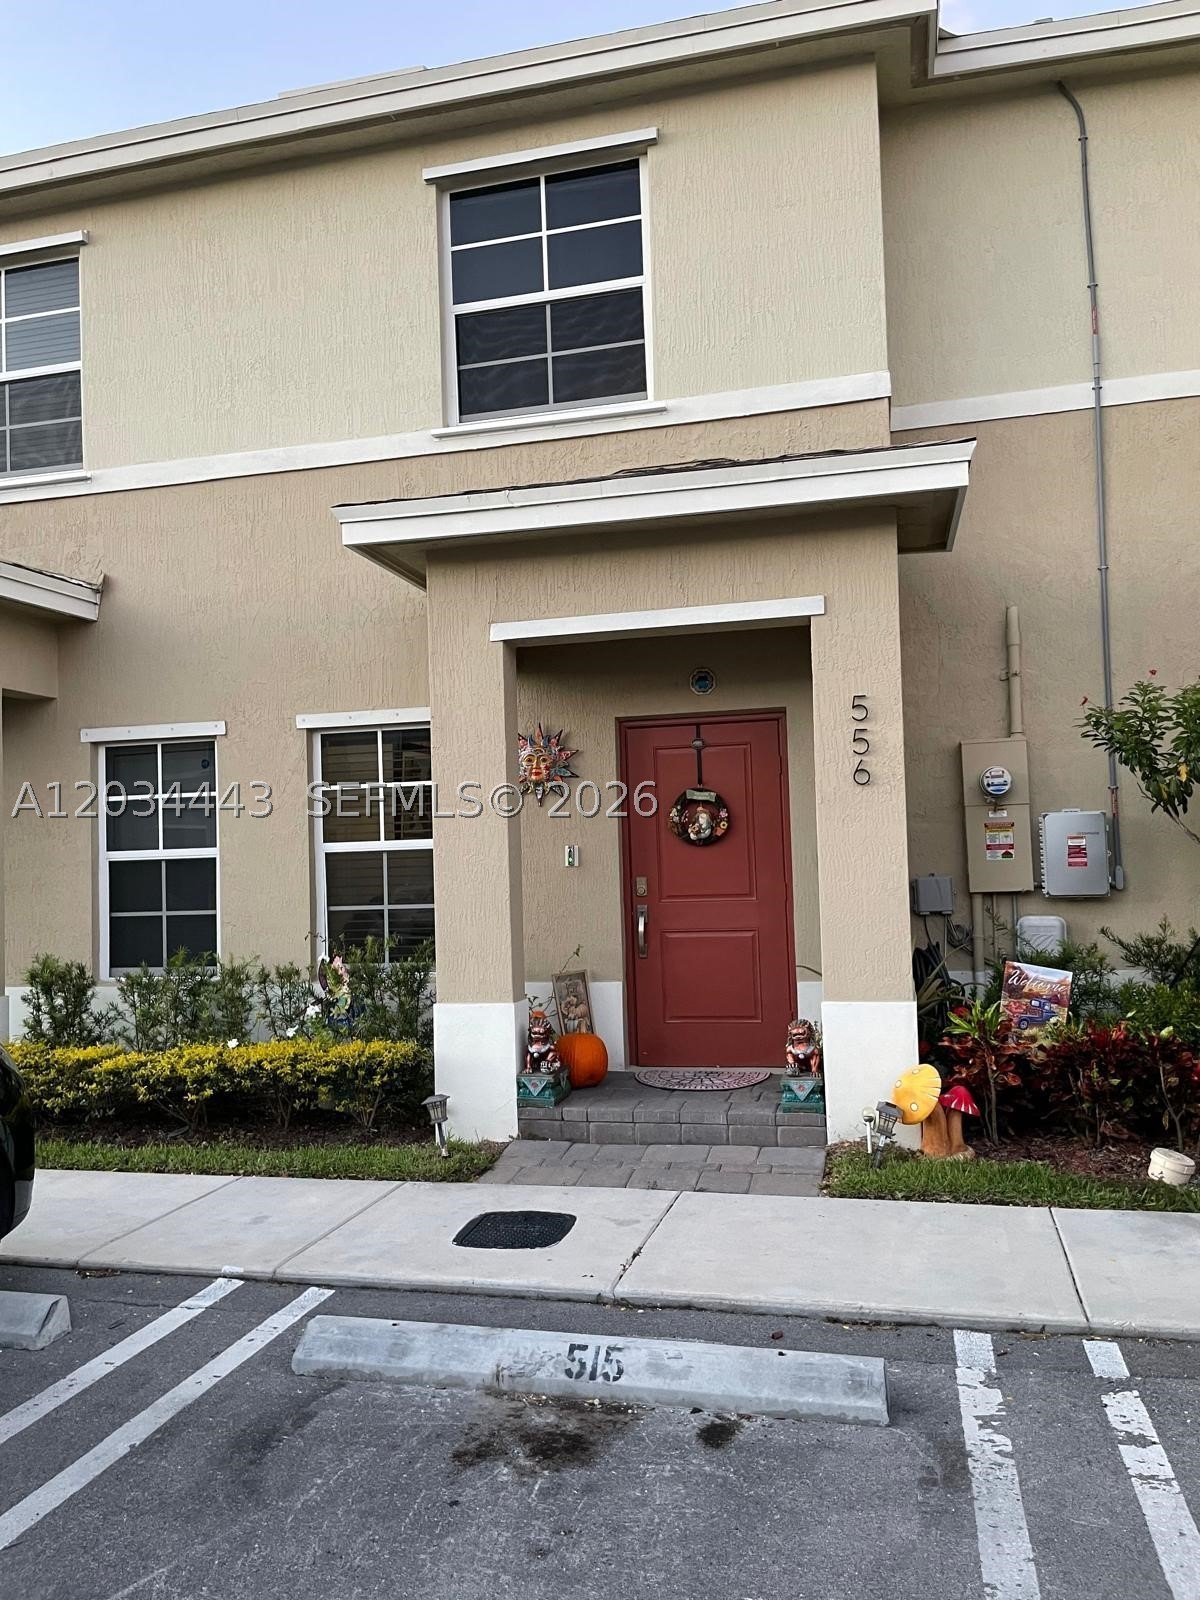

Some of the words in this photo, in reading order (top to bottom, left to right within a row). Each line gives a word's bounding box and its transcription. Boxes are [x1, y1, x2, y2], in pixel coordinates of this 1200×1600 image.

[851, 694, 871, 786] 556
[1008, 969, 1068, 993] Welcome
[564, 1343, 625, 1382] 515
